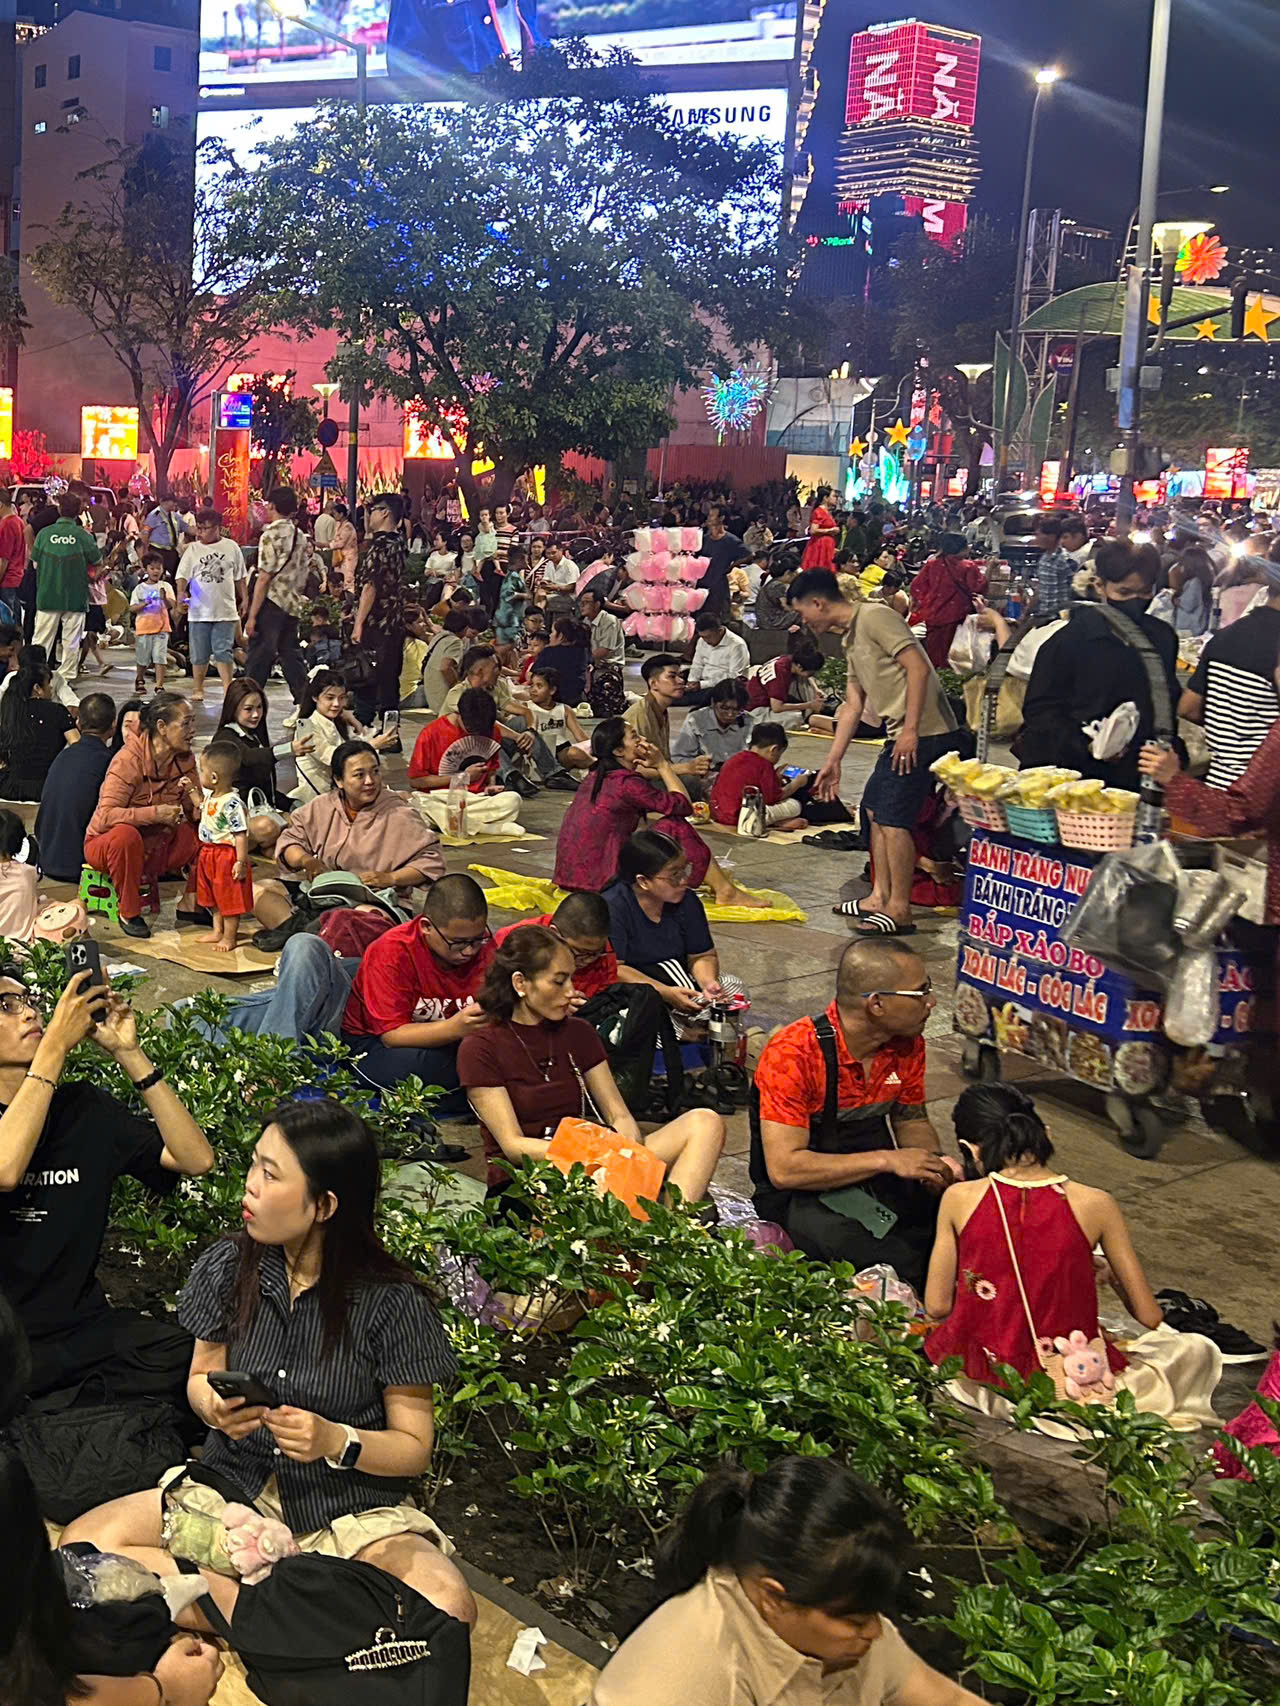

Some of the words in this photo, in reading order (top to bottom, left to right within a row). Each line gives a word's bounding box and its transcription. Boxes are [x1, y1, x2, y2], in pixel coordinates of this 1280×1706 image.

[671, 105, 771, 127] AMSUNG
[50, 534, 77, 545] Grab
[969, 837, 1012, 875] BÁNH
[1011, 848, 1064, 889] TRÁNG
[972, 873, 1013, 913] BÁNH
[1013, 887, 1066, 928] TRÁNG
[968, 909, 1013, 948] BẮP
[1012, 930, 1067, 967] XÀO
[1039, 971, 1073, 1012] CÓC
